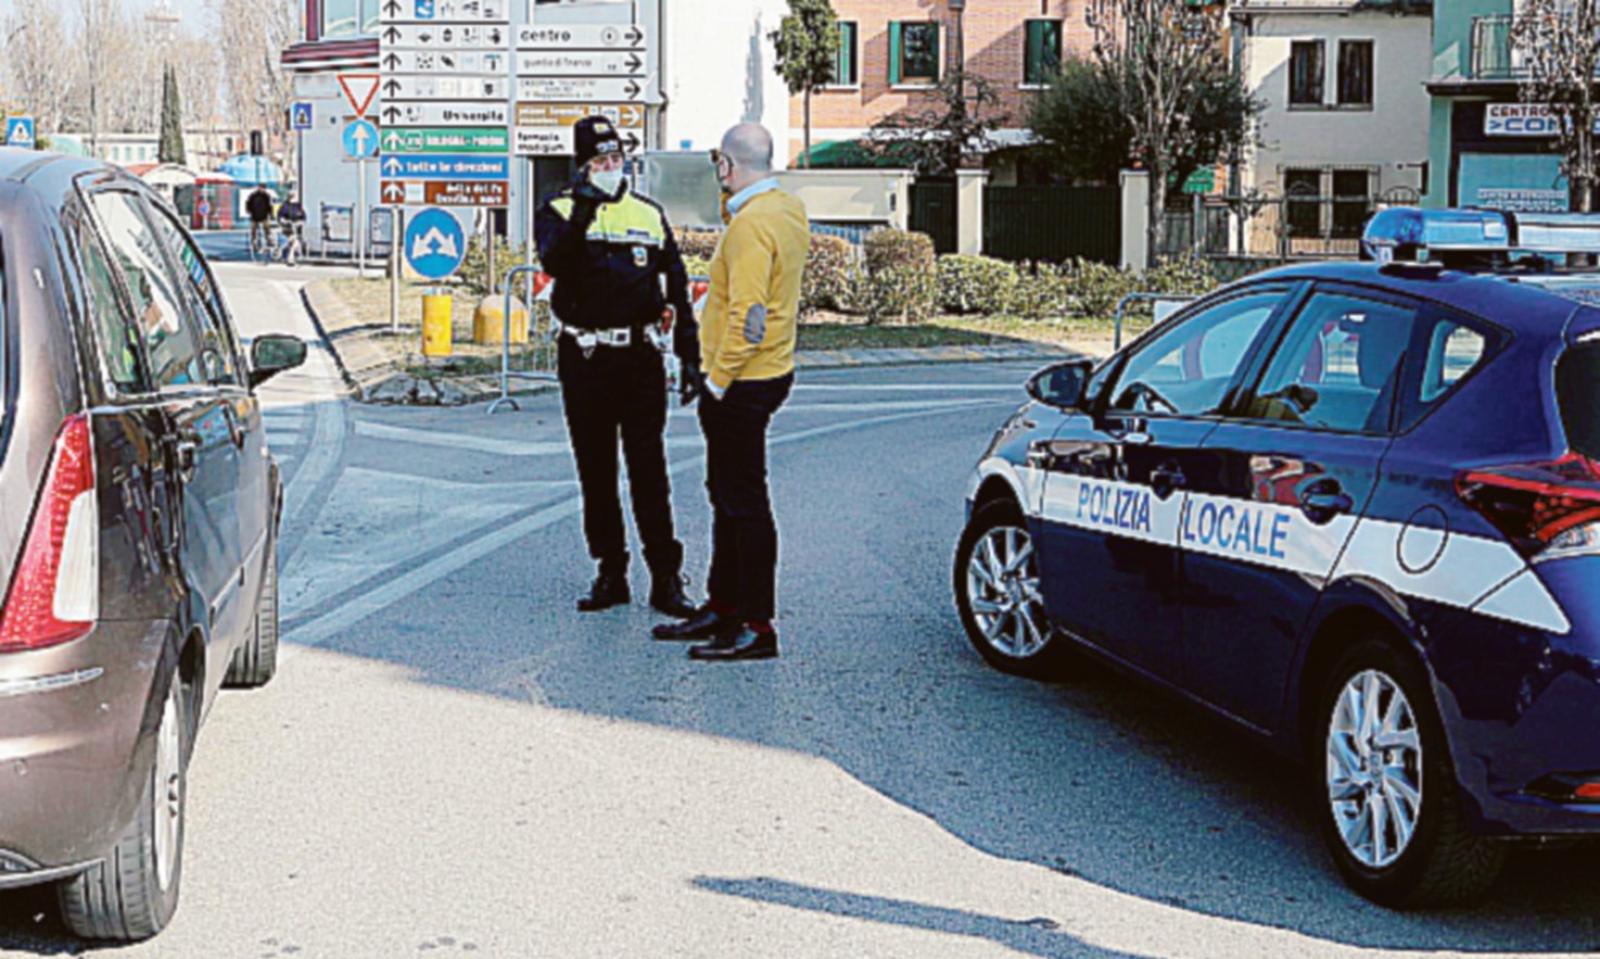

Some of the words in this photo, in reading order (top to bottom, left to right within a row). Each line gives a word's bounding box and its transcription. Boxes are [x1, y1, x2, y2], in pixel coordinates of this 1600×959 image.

[520, 30, 571, 41] centro
[1490, 106, 1549, 117] CENTRO
[1077, 482, 1151, 532] POLIZIA
[1183, 500, 1290, 559] LOCALE
